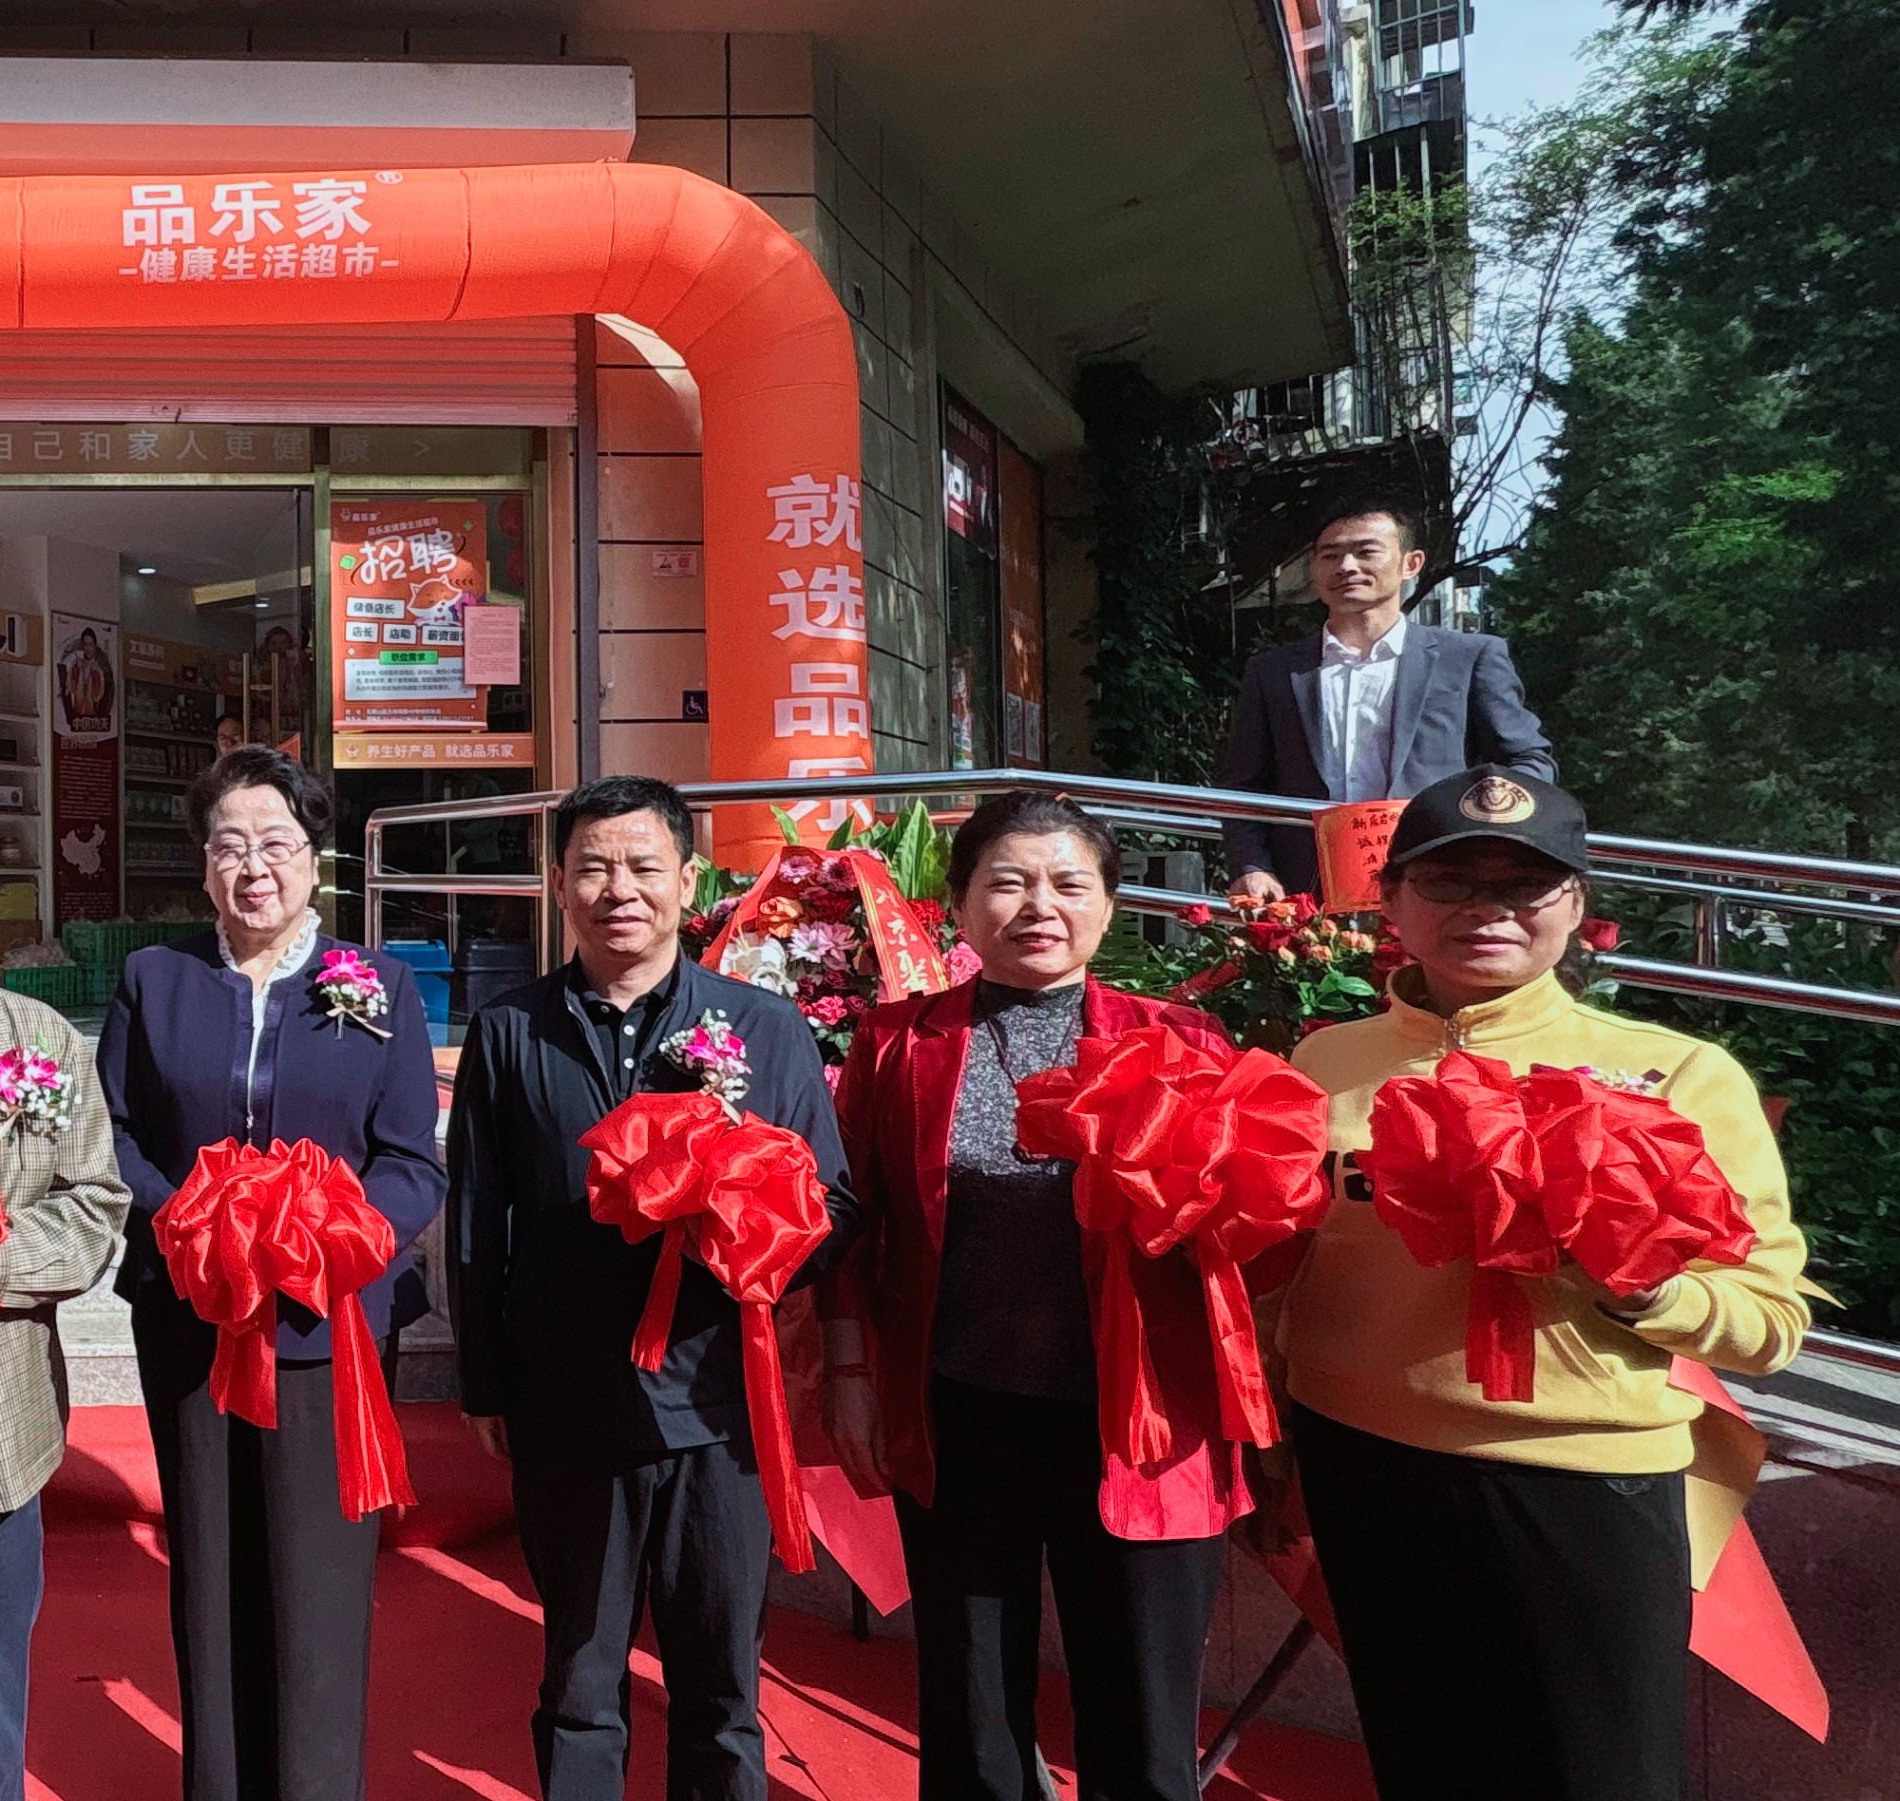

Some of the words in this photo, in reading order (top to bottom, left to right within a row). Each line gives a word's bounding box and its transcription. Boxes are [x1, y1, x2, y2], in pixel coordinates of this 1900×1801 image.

[122, 178, 372, 246] 品乐家
[359, 528, 457, 584] 招聘
[352, 626, 373, 638] 店长
[389, 628, 411, 640] 店助
[367, 744, 436, 759] 养生好产品
[445, 744, 515, 759] 就选品乐家
